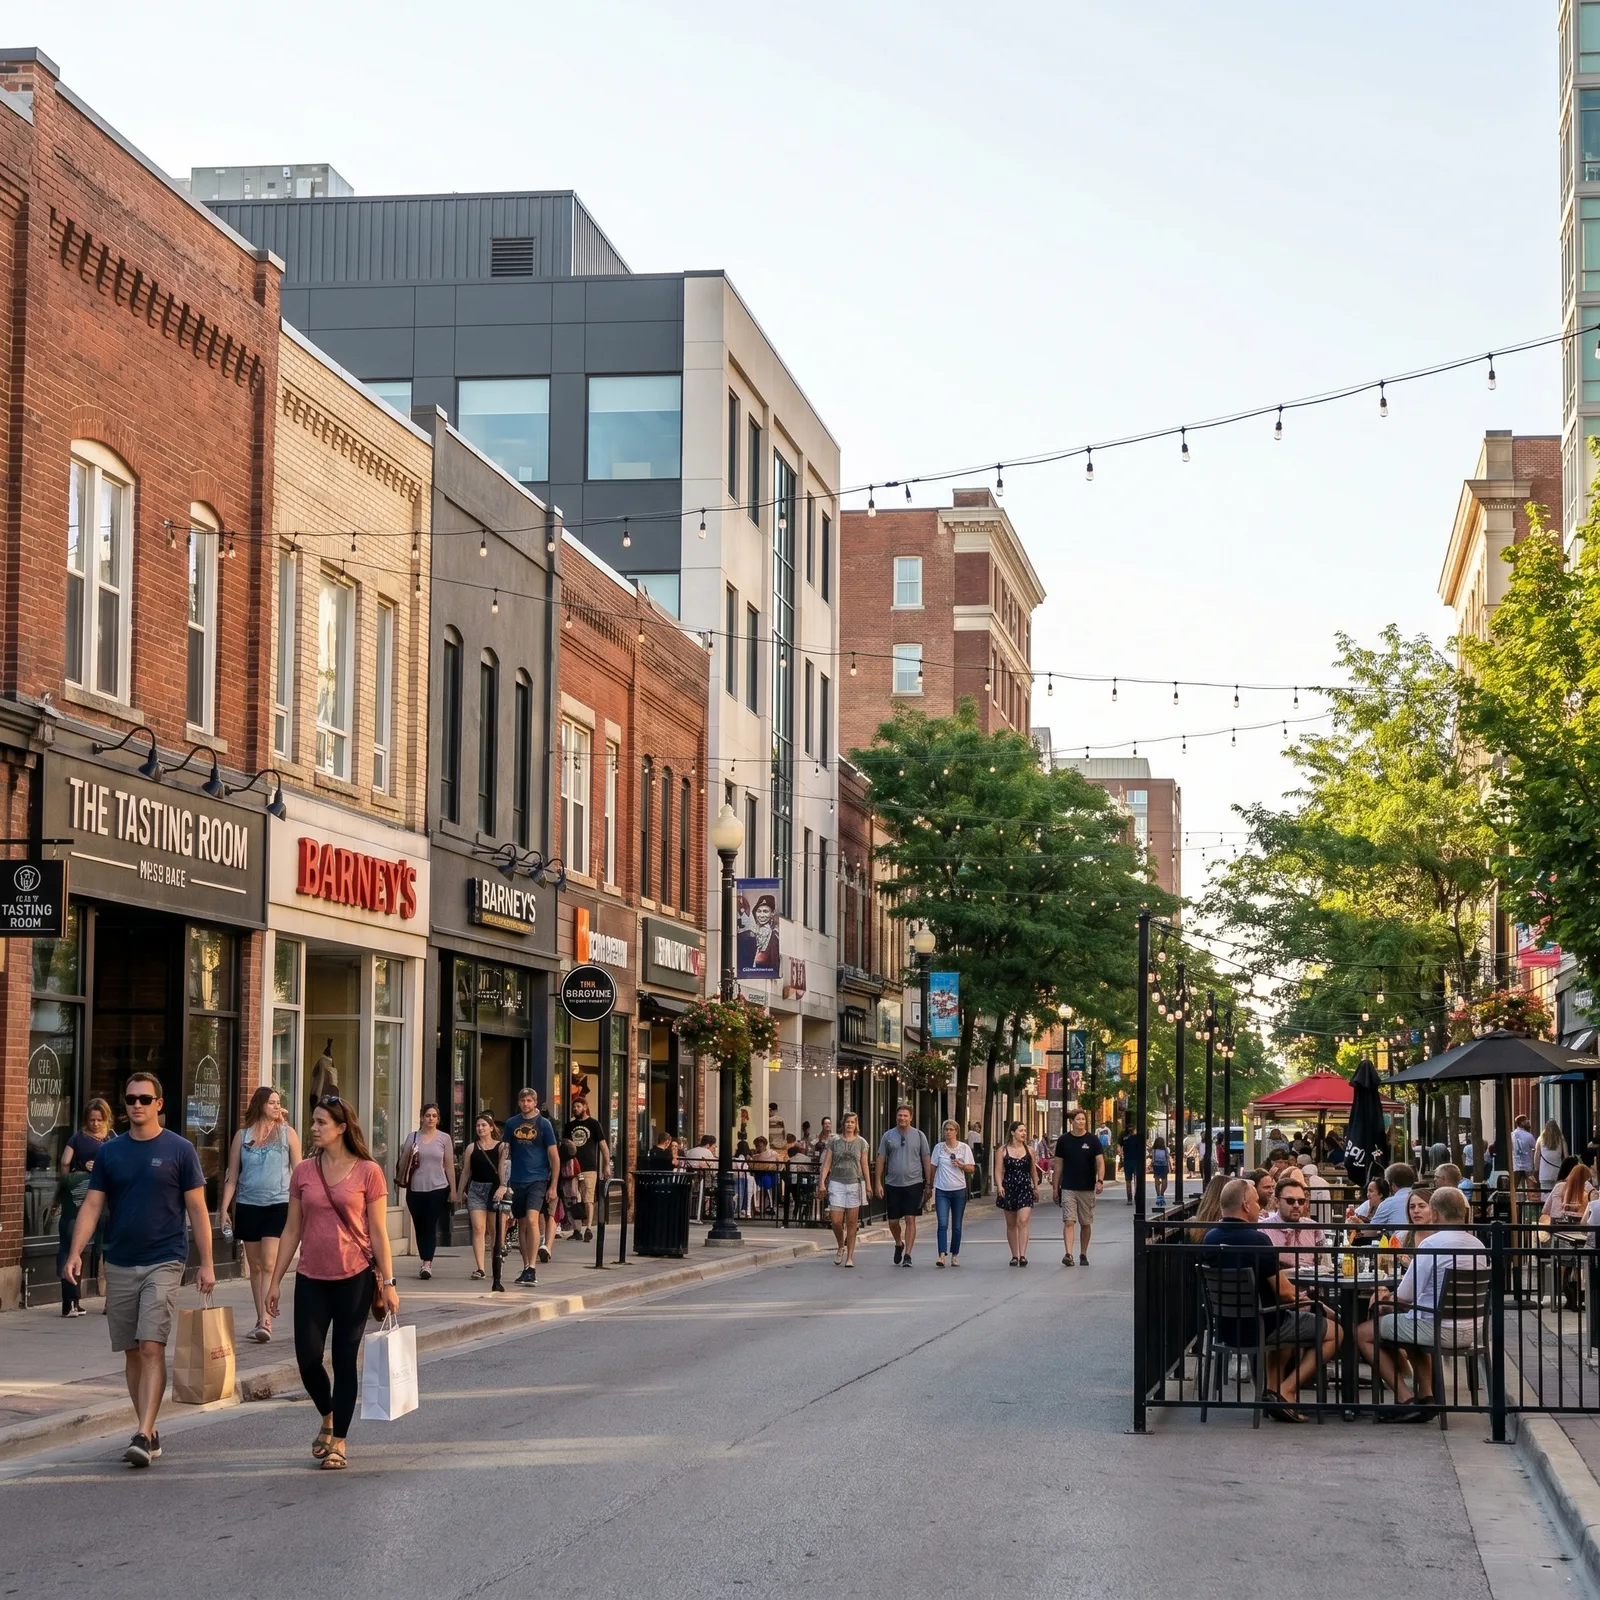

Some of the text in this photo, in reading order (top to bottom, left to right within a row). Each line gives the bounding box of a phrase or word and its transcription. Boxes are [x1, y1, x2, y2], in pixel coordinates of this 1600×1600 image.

[70, 777, 248, 870] THE TASTING ROOM
[297, 837, 416, 919] BARNEY'S
[482, 878, 536, 923] BARNEY'S
[1, 904, 52, 916] TASTING
[10, 917, 42, 928] ROOM
